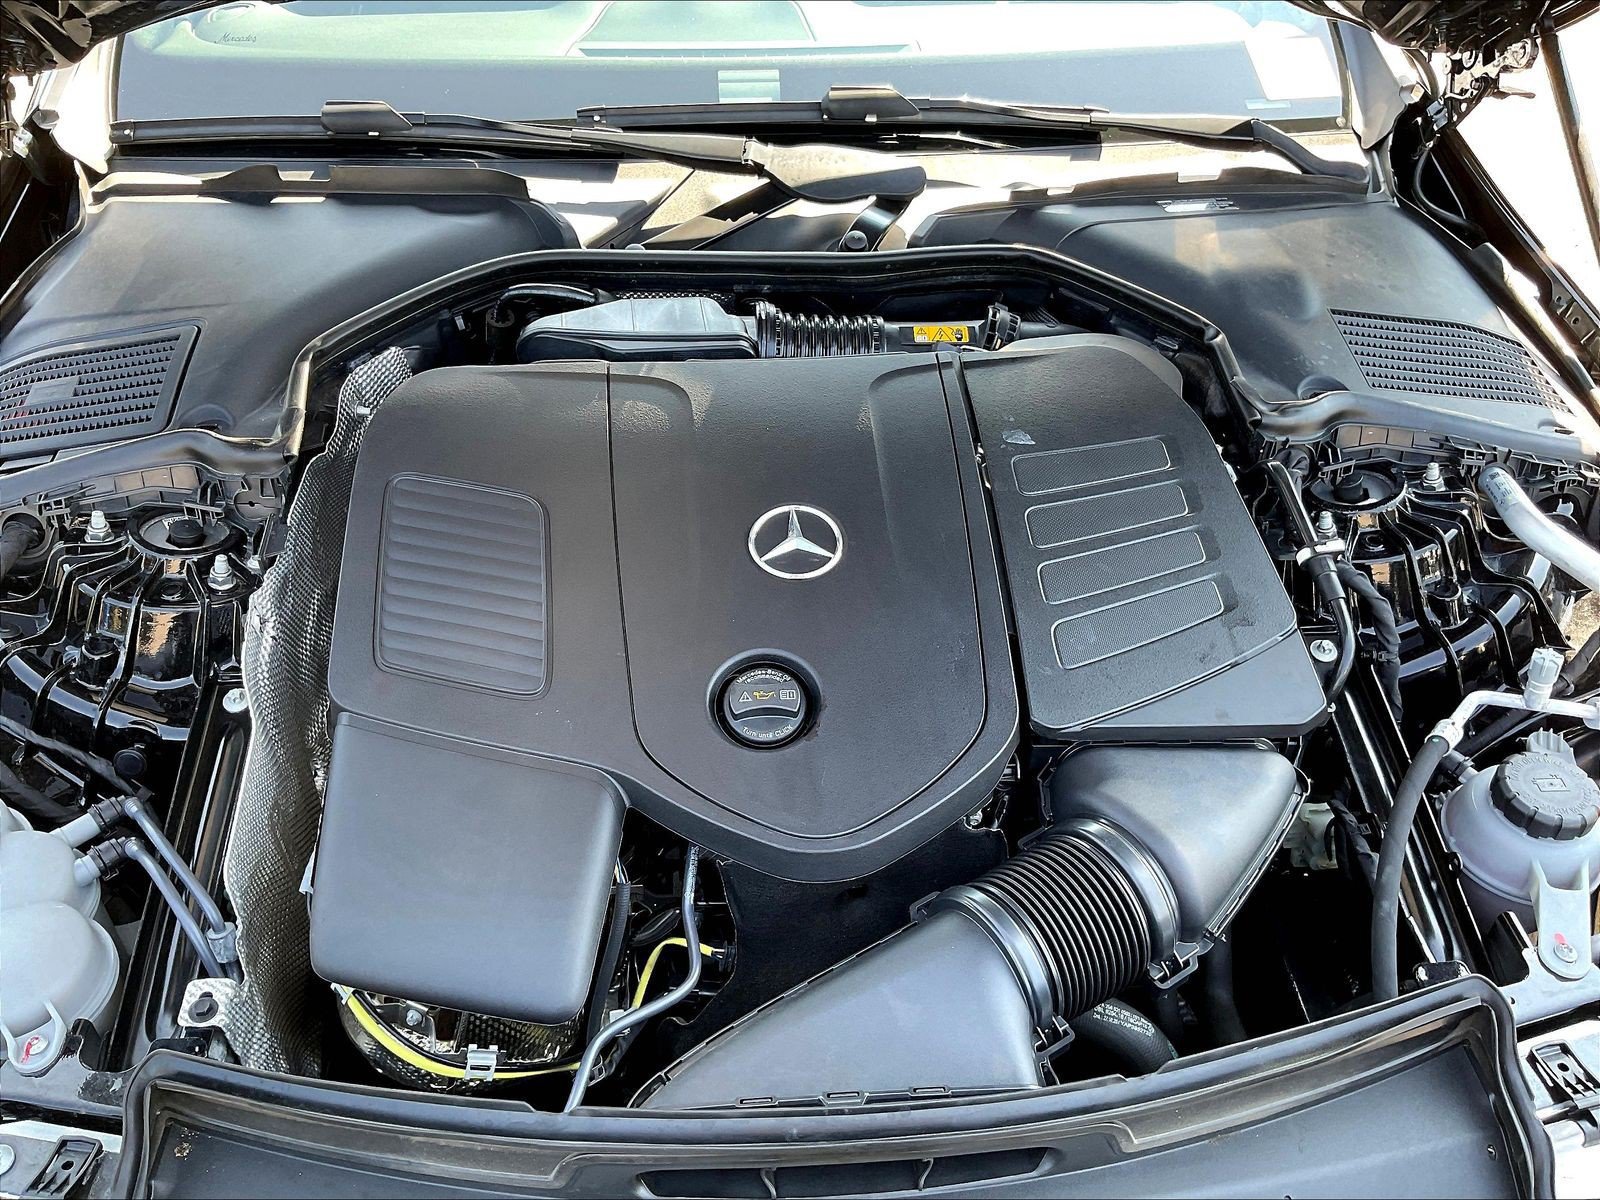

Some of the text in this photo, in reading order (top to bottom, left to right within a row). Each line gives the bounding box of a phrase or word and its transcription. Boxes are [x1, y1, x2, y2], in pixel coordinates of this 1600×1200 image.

[736, 669, 782, 685] Mercedes-Benz
[744, 674, 785, 684] recommended
[742, 726, 757, 737] Turn
[774, 724, 793, 737] CLICK
